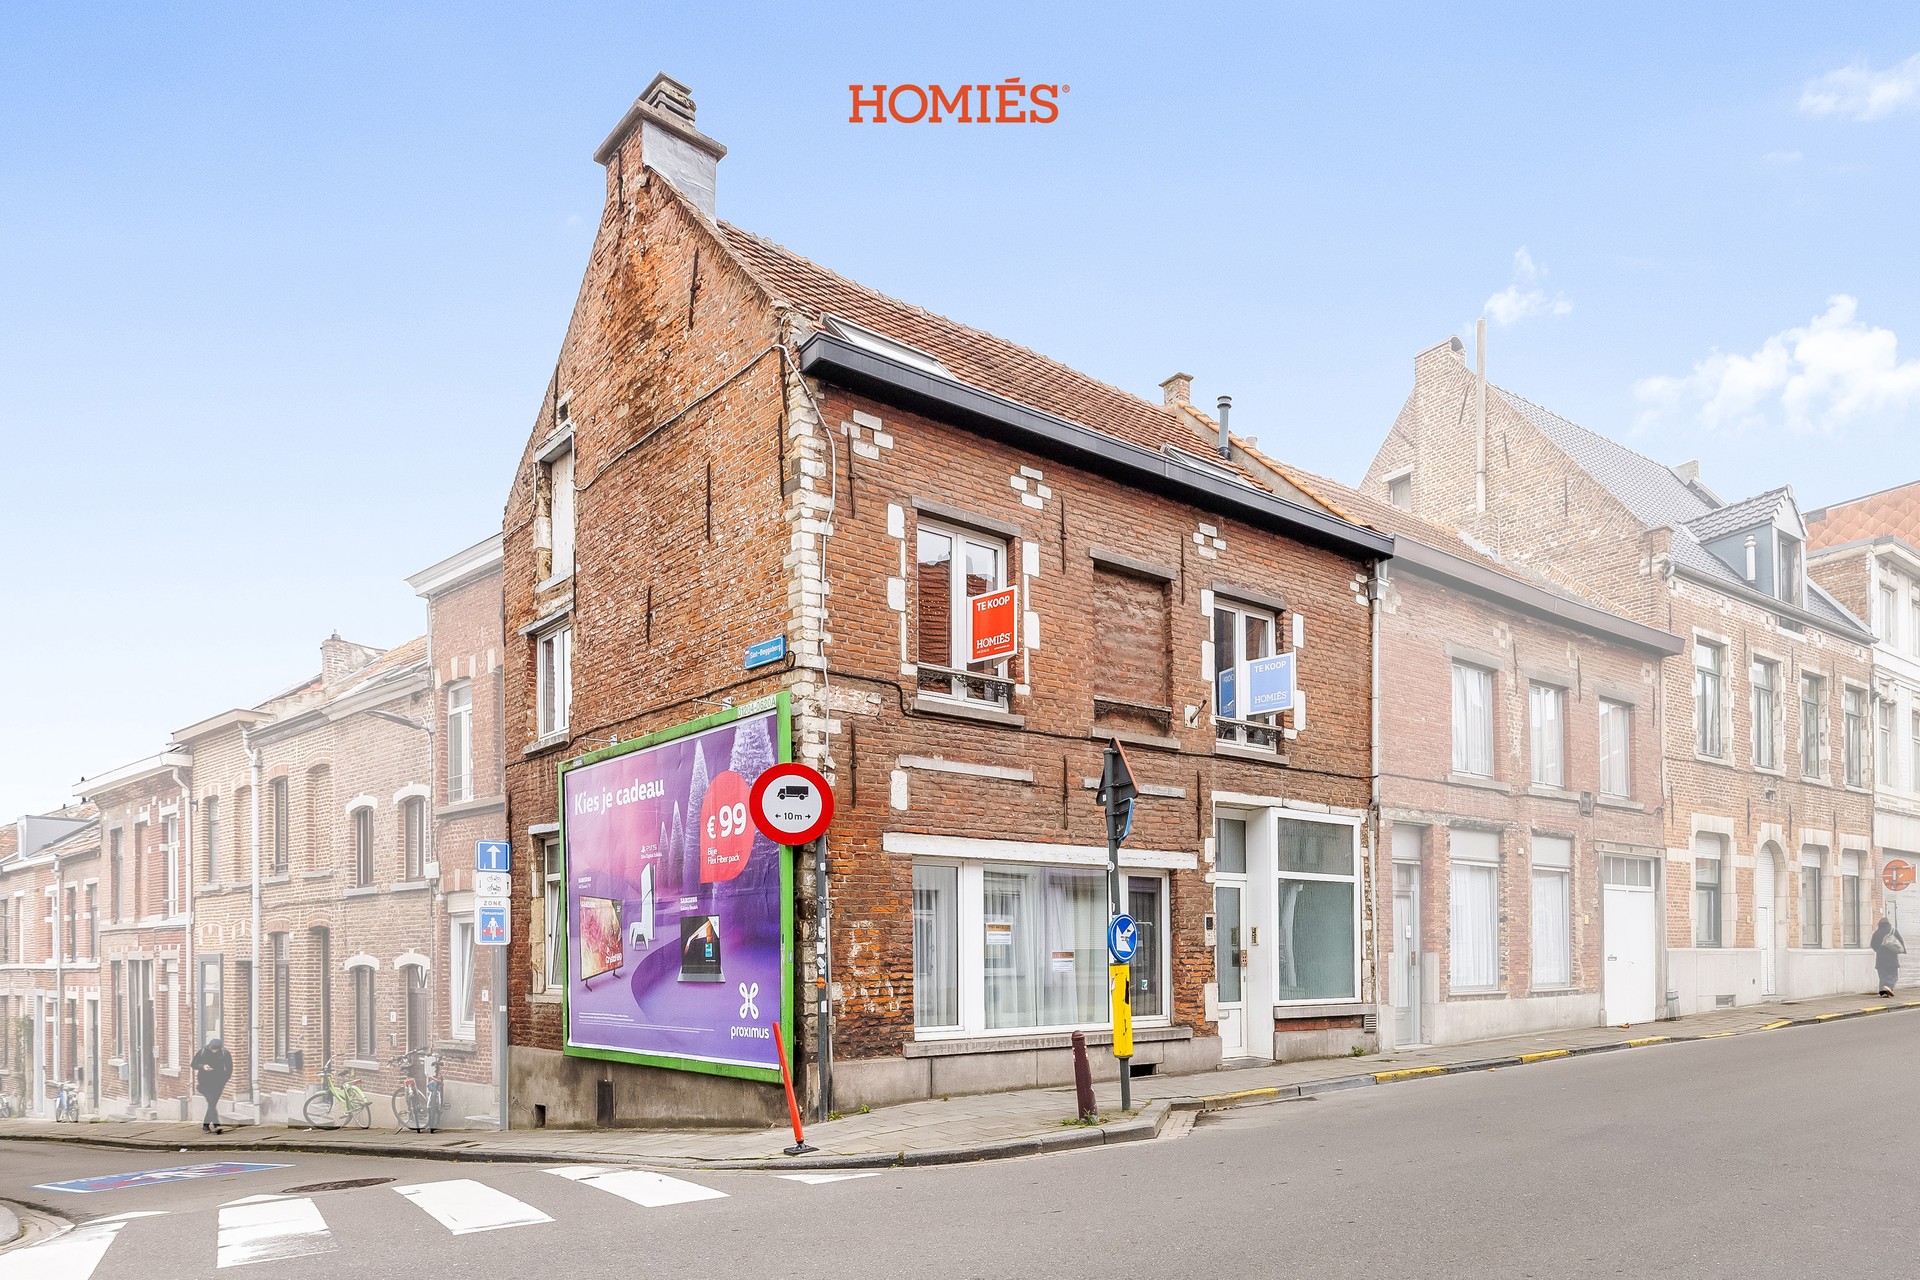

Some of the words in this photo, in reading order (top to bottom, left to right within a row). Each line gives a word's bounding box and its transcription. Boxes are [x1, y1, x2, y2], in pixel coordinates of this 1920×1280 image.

[976, 601, 986, 611] TE
[987, 595, 1010, 609] KOOP
[1254, 664, 1263, 673] TE
[1264, 660, 1286, 671] KOOP
[574, 791, 599, 815] Kies
[601, 786, 613, 815] je
[616, 778, 664, 805] cadeau
[707, 815, 717, 839] €
[719, 802, 747, 838] 99
[728, 852, 740, 864] pack
[730, 1026, 770, 1039] proximus
